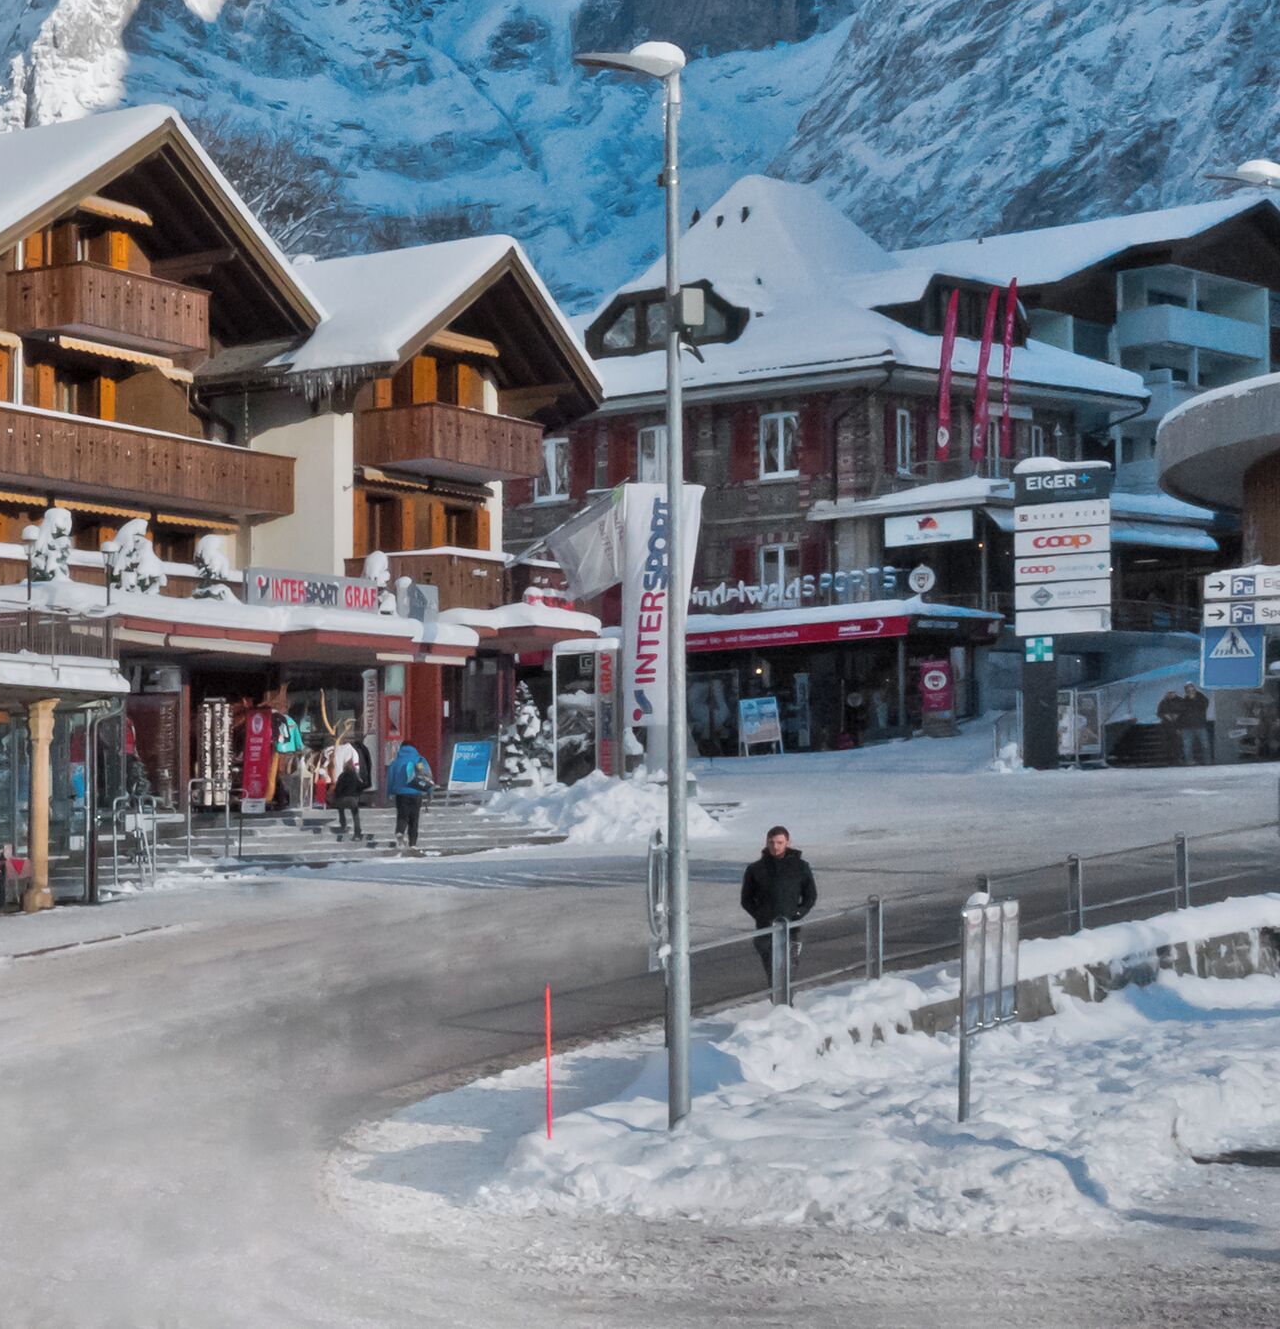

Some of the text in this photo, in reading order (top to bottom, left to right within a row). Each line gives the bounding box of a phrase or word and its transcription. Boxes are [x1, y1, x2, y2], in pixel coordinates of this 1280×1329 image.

[1033, 534, 1092, 549] coop
[1020, 565, 1056, 574] coop
[272, 579, 377, 609] INTERSPORT GRAF
[690, 578, 801, 607] indelwald
